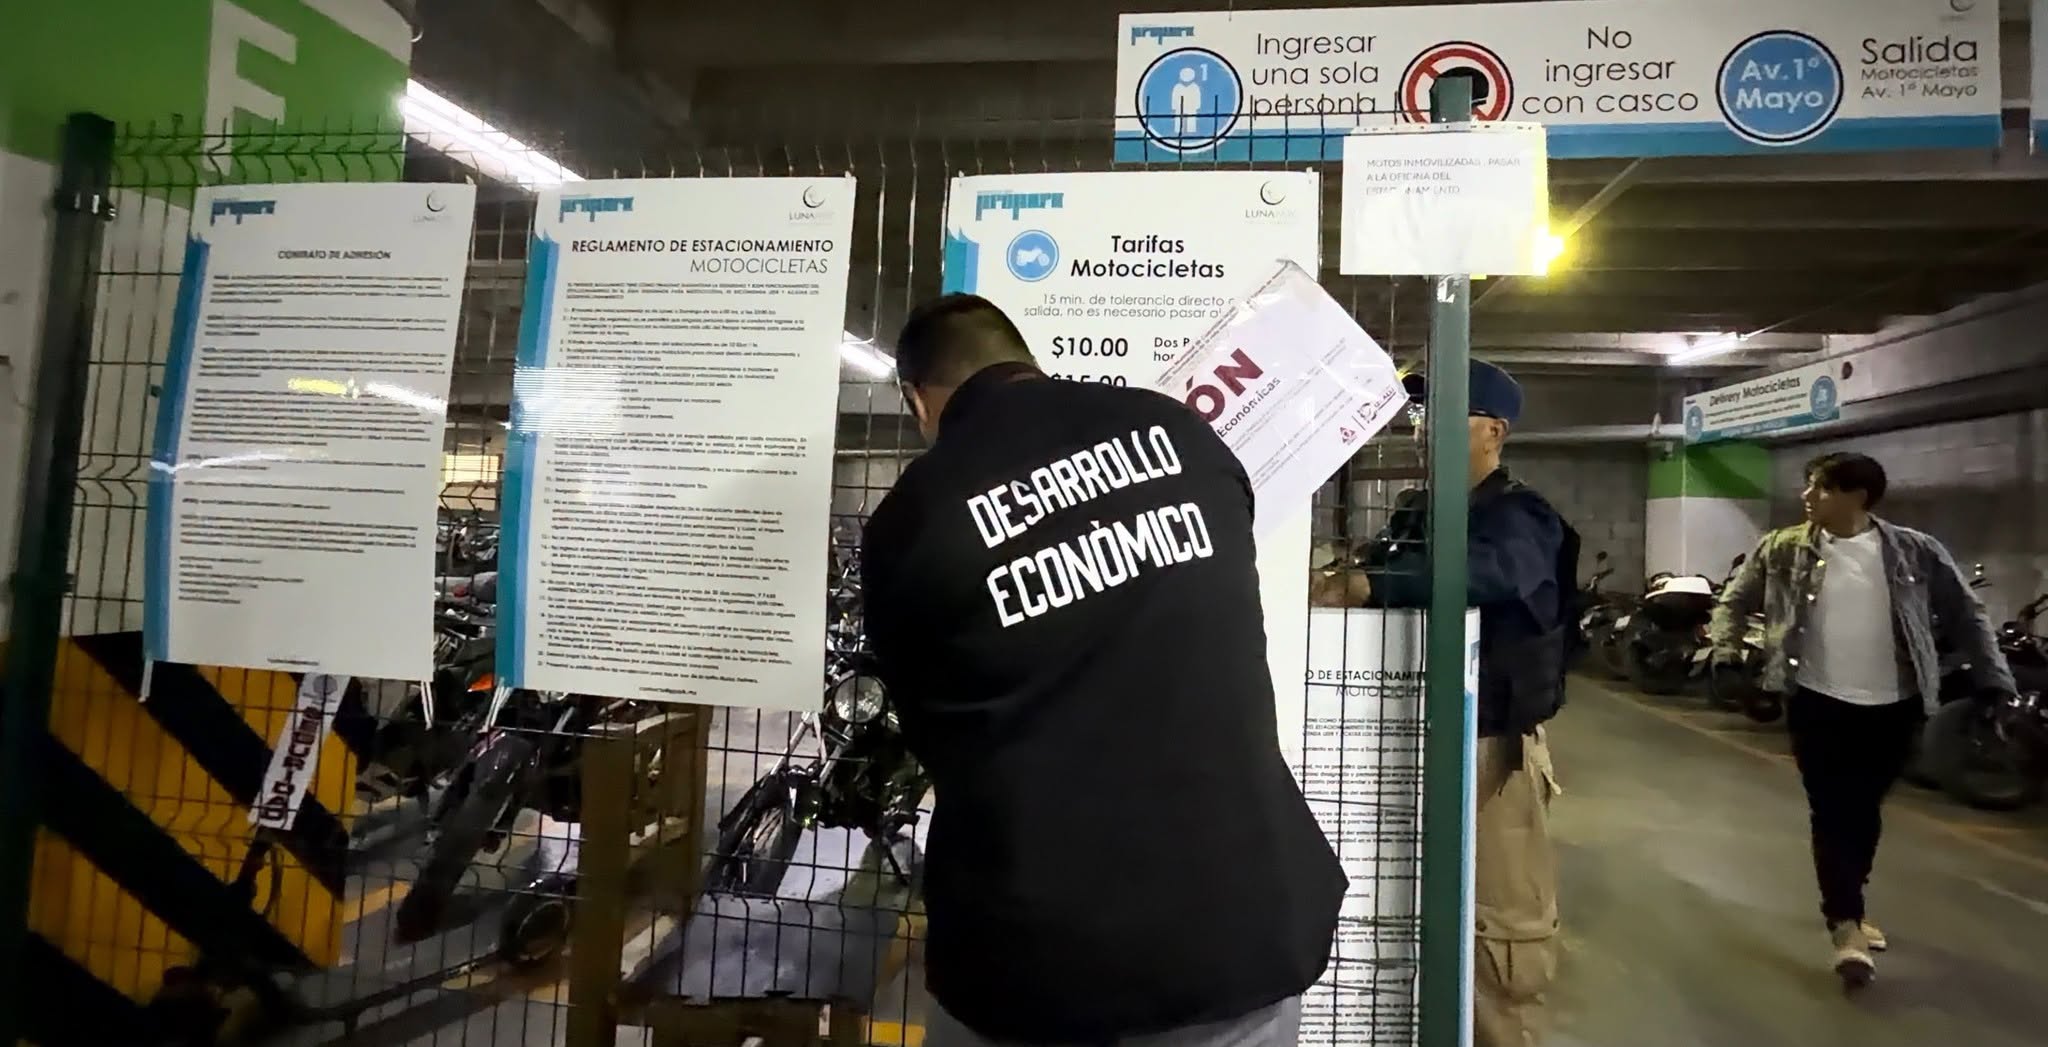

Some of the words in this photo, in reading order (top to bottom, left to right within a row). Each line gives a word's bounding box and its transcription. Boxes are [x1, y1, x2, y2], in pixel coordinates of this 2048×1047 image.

[1256, 33, 1377, 60] Ingresar
[1587, 26, 1632, 49] No
[1861, 35, 1977, 65] Salida
[1252, 67, 1310, 85] una
[1320, 62, 1378, 84] sola
[1545, 57, 1676, 87] ingresar
[1861, 66, 1978, 80] Motocicletas
[1735, 87, 1823, 115] Mayo
[1861, 86, 1892, 98] Av.
[1922, 84, 1977, 99] Mayo
[1254, 97, 1376, 120] persona
[1522, 97, 1585, 115] con
[1596, 92, 1699, 113] casco
[572, 239, 665, 253] REGLAMENTO
[669, 240, 687, 252] DE
[692, 239, 834, 253] ESTACIONAMIENTO
[1111, 235, 1184, 254] Tarifas
[690, 257, 828, 274] MOTOCICLETAS
[1070, 259, 1225, 279] Motocicletas
[1060, 294, 1085, 305] min.
[1089, 294, 1106, 305] de
[1110, 294, 1175, 306] tolerancia
[1179, 295, 1226, 306] directo
[1023, 306, 1063, 318] salida,
[1067, 308, 1083, 317] no
[1086, 309, 1101, 317] es
[1103, 308, 1167, 318] necesario
[1169, 308, 1206, 320] pasar
[1051, 335, 1129, 359] $10.00
[1154, 337, 1178, 348] Dos
[967, 425, 1182, 549] DESARROLLO
[1318, 670, 1333, 680] DE
